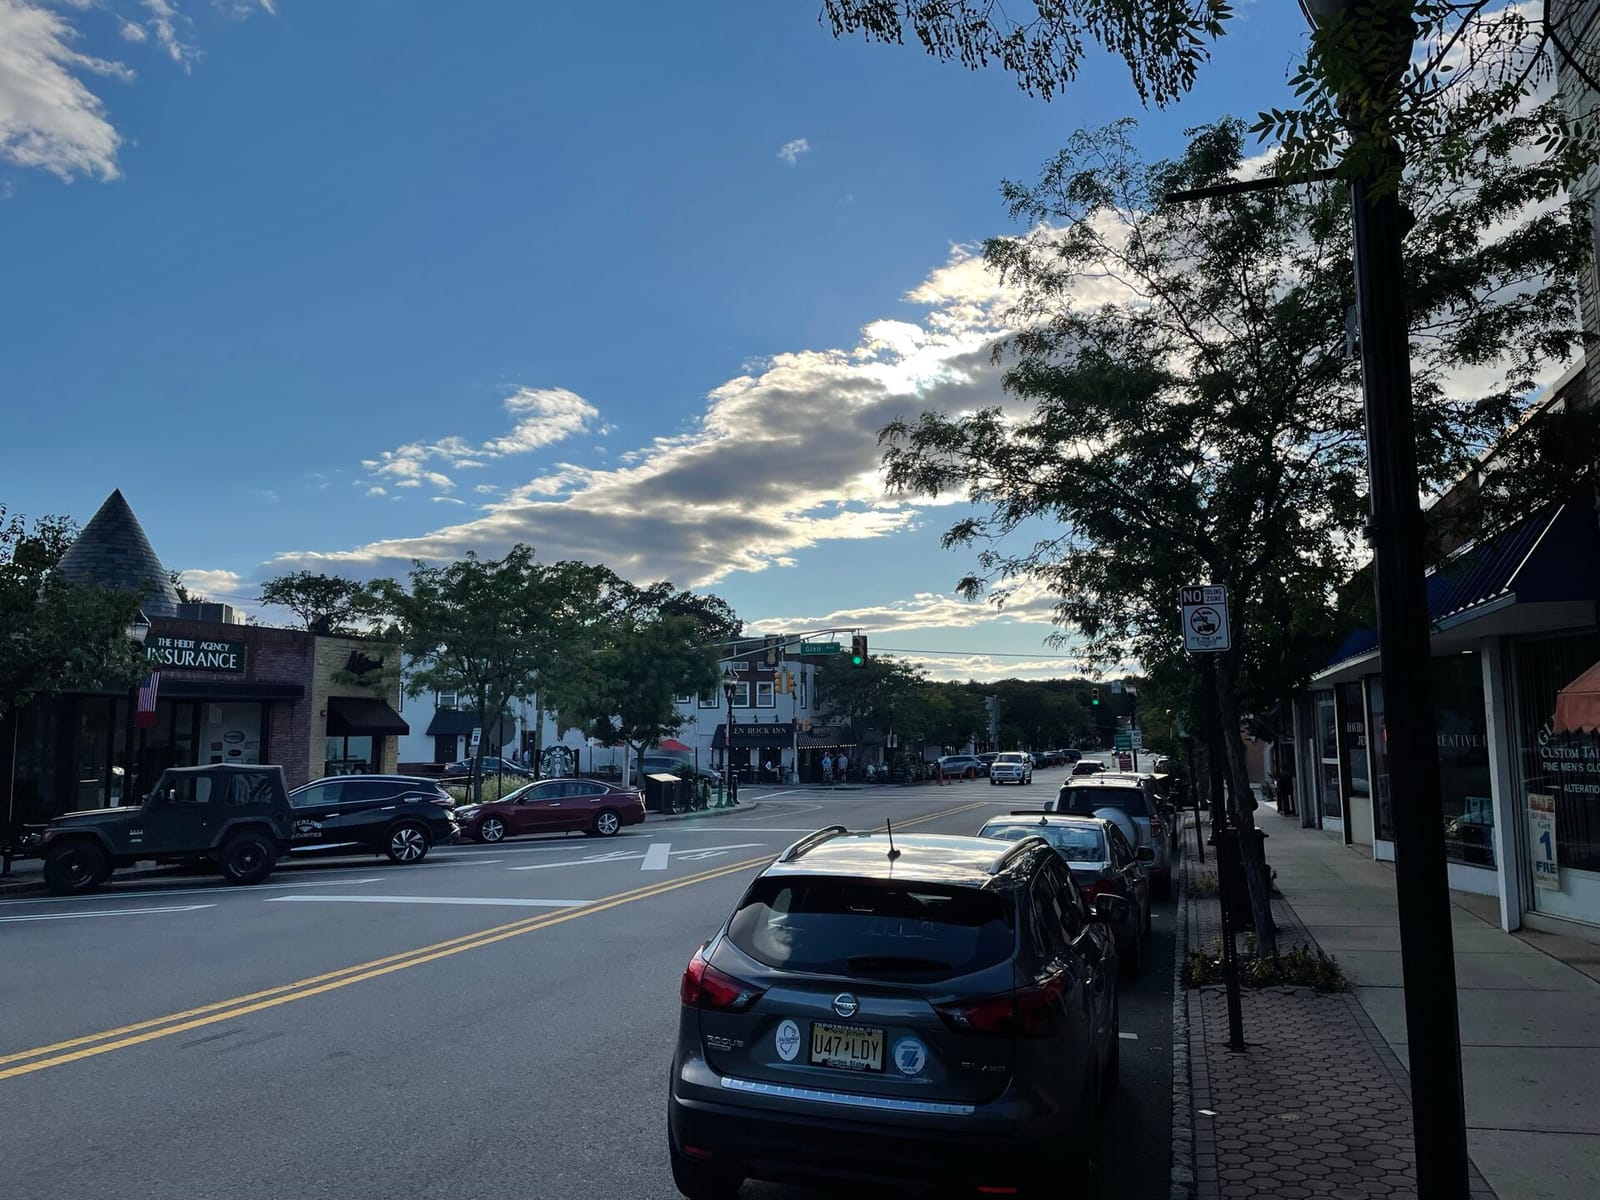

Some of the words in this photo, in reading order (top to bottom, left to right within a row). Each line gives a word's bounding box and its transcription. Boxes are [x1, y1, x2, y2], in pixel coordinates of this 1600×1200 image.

[1183, 590, 1202, 603] NO
[157, 637, 173, 648] THE
[174, 639, 195, 649] HEIDT
[199, 641, 230, 652] AGENCY
[805, 645, 822, 653] Glen
[147, 647, 237, 669] INSURANCE
[747, 727, 770, 735] ROCK
[772, 727, 787, 735] INN
[1436, 734, 1478, 748] REATIVE
[1541, 746, 1580, 759] CUSTOM
[1543, 761, 1560, 772] FINE
[1561, 762, 1585, 773] MEN'S
[1539, 831, 1553, 861] 1
[706, 1034, 744, 1048] ROGUE
[814, 1034, 842, 1057] U47
[851, 1038, 880, 1061] LDY
[827, 1057, 848, 1066] Garden
[849, 1059, 865, 1068] State
